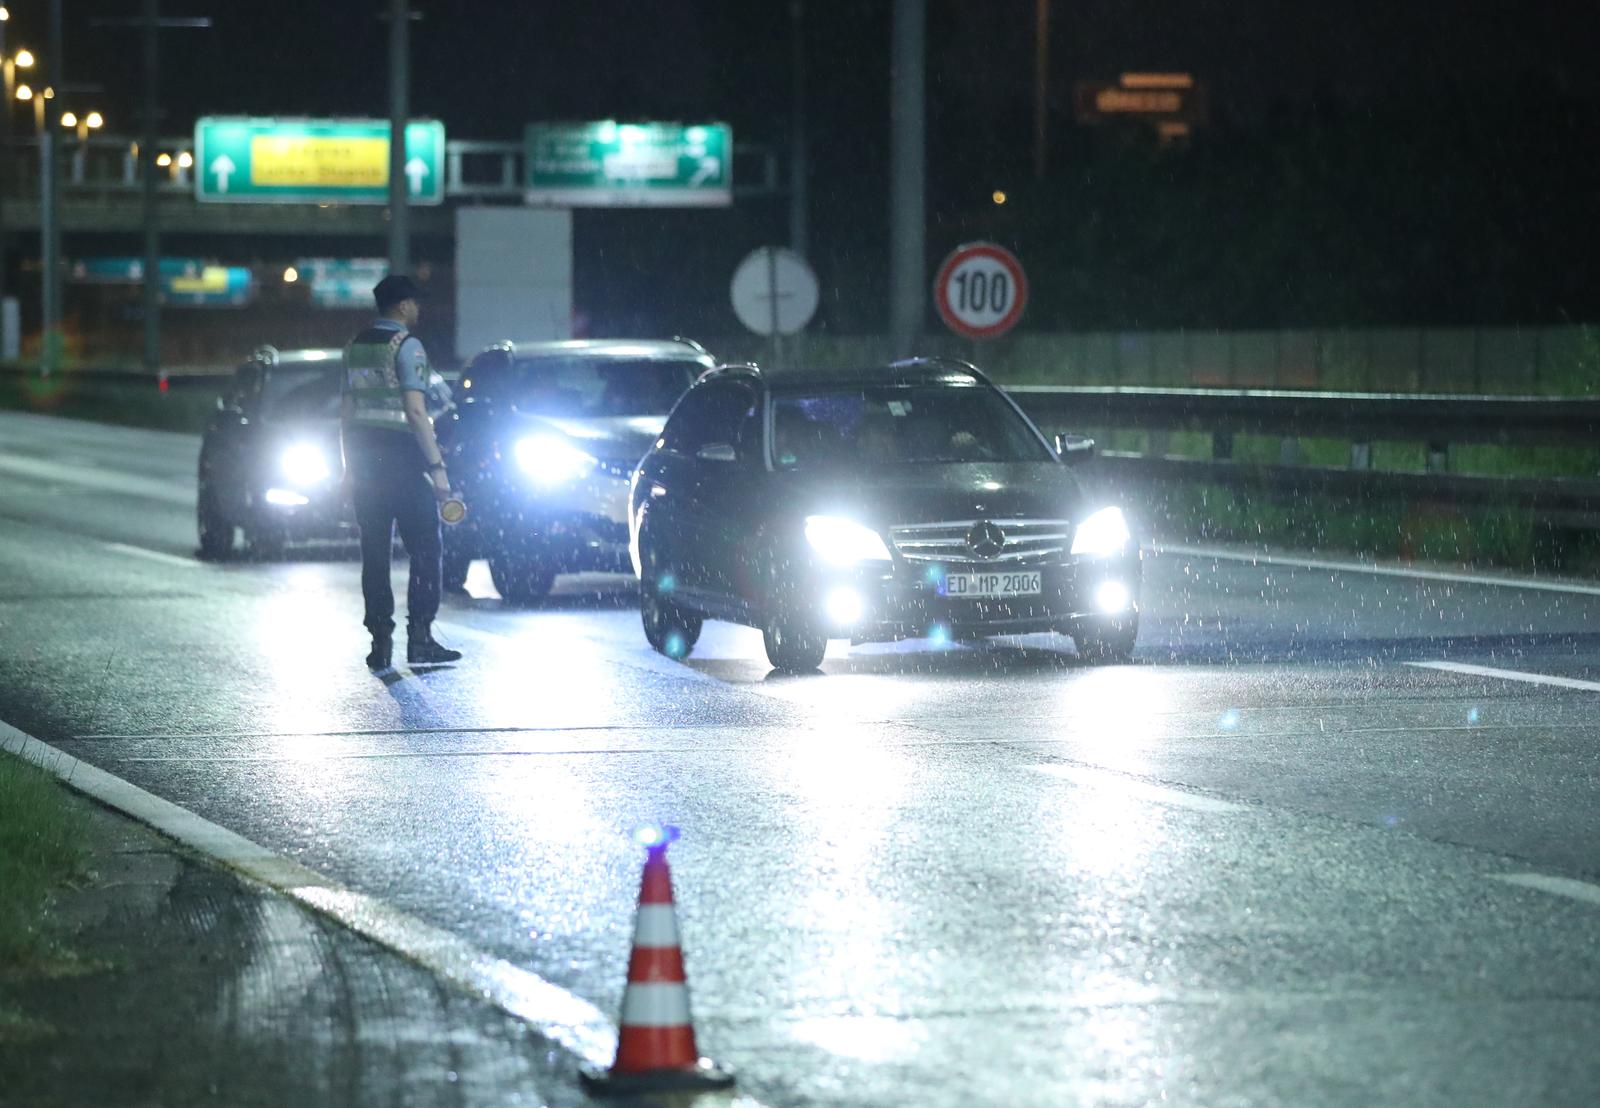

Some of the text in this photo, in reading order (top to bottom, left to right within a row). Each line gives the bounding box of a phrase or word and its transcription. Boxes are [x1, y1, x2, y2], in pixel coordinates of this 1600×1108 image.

[955, 269, 1007, 313] 100
[947, 574, 1040, 593] ED MP 2006
